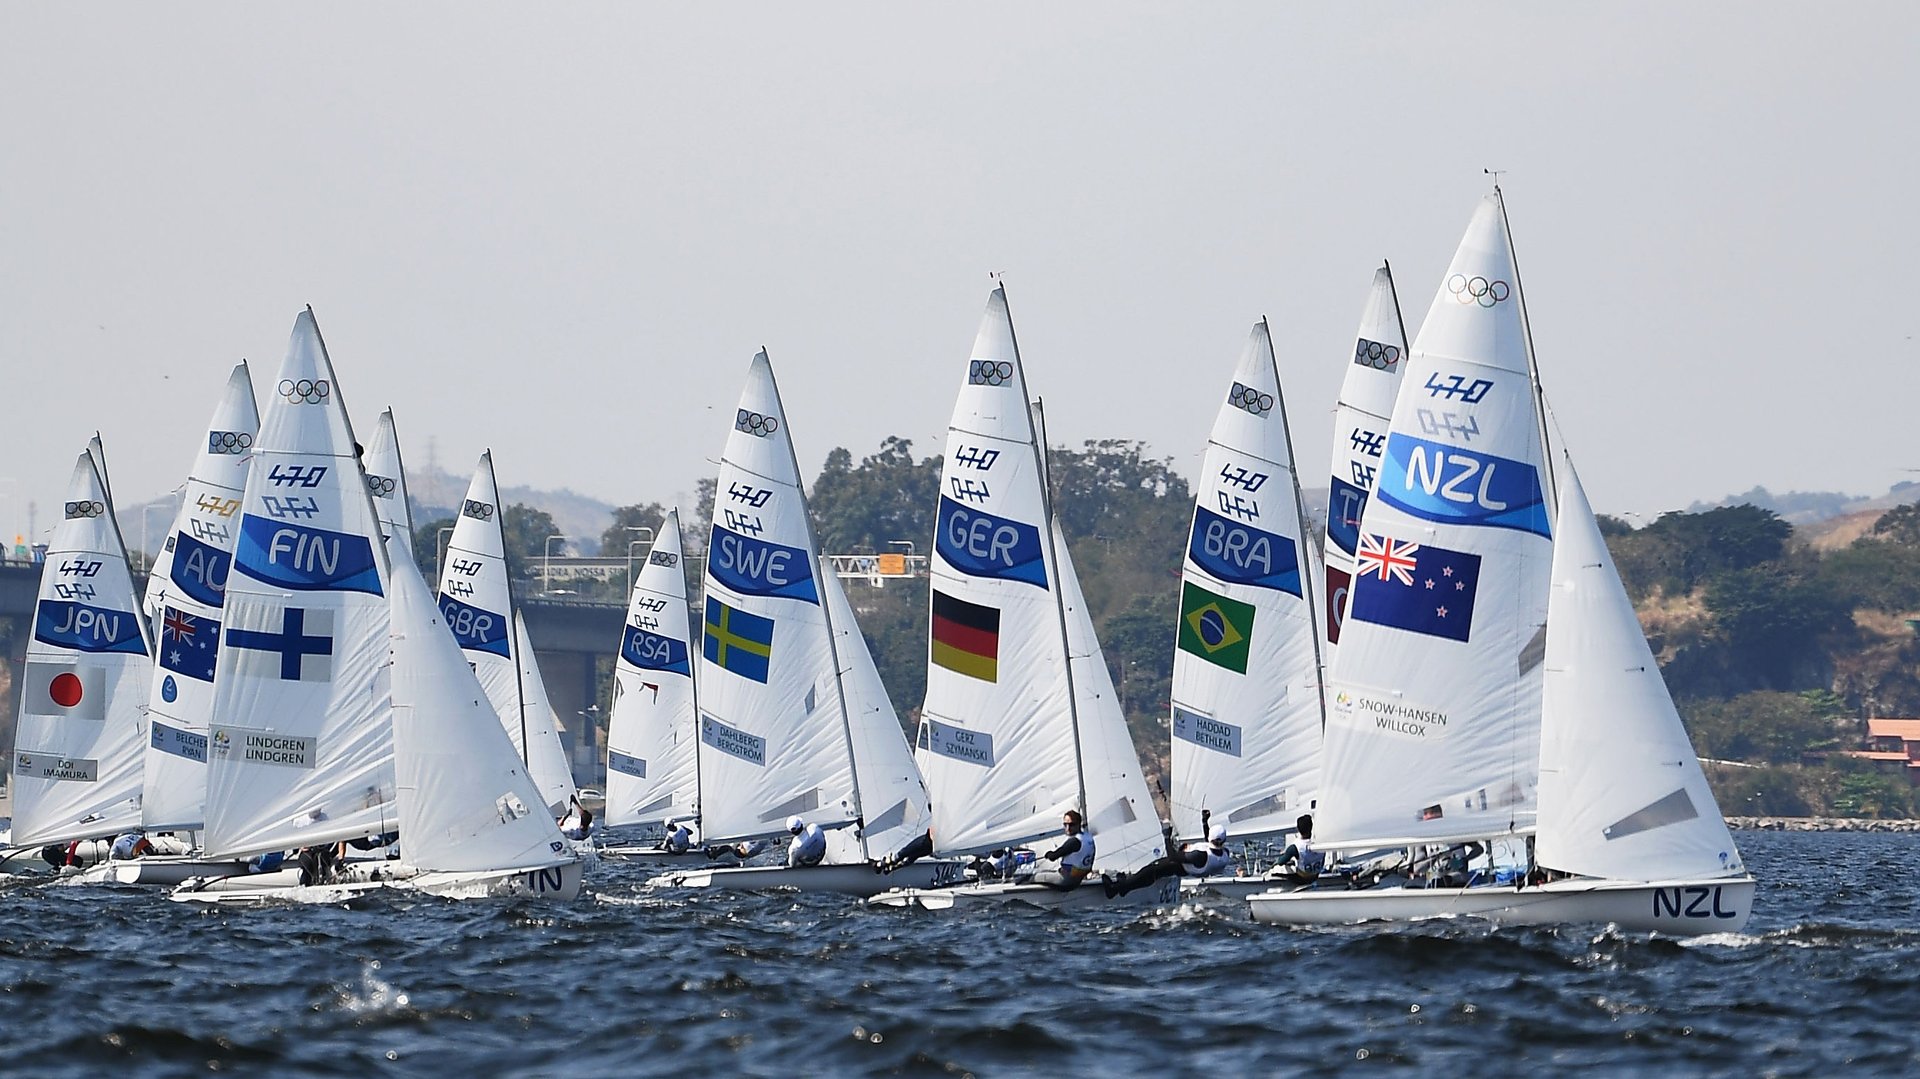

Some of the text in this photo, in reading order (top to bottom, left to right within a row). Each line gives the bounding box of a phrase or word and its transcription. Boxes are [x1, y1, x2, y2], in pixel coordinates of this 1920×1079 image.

[1424, 372, 1495, 404] 470
[955, 444, 1001, 471] 470
[267, 464, 328, 488] 470
[1220, 462, 1269, 493] 470
[1405, 445, 1507, 511] NZL
[195, 493, 241, 518] 470
[727, 481, 774, 508] 470
[948, 510, 1019, 567] GER
[1204, 519, 1271, 575] BRA
[268, 528, 341, 576] FIN
[718, 535, 792, 585] SWE
[59, 560, 103, 577] 470
[452, 558, 483, 576] 470
[638, 596, 668, 613] 470
[54, 606, 119, 643] JPN
[444, 602, 493, 643] GBR
[630, 632, 670, 664] RSA
[1359, 698, 1448, 726] SNOW-HANSEN
[719, 726, 760, 749] DAHLBERG
[955, 730, 975, 745] GERZ
[1196, 717, 1231, 738] HADDAD
[1375, 716, 1427, 737] WILLCOX
[182, 743, 202, 759] RYAN
[246, 735, 306, 751] LINDGREN
[1195, 730, 1232, 751] BETHLEM
[58, 759, 74, 769] DOI
[245, 750, 305, 765] LINDGREN
[43, 768, 88, 779] IMAMURA
[1653, 885, 1737, 918] NZL
